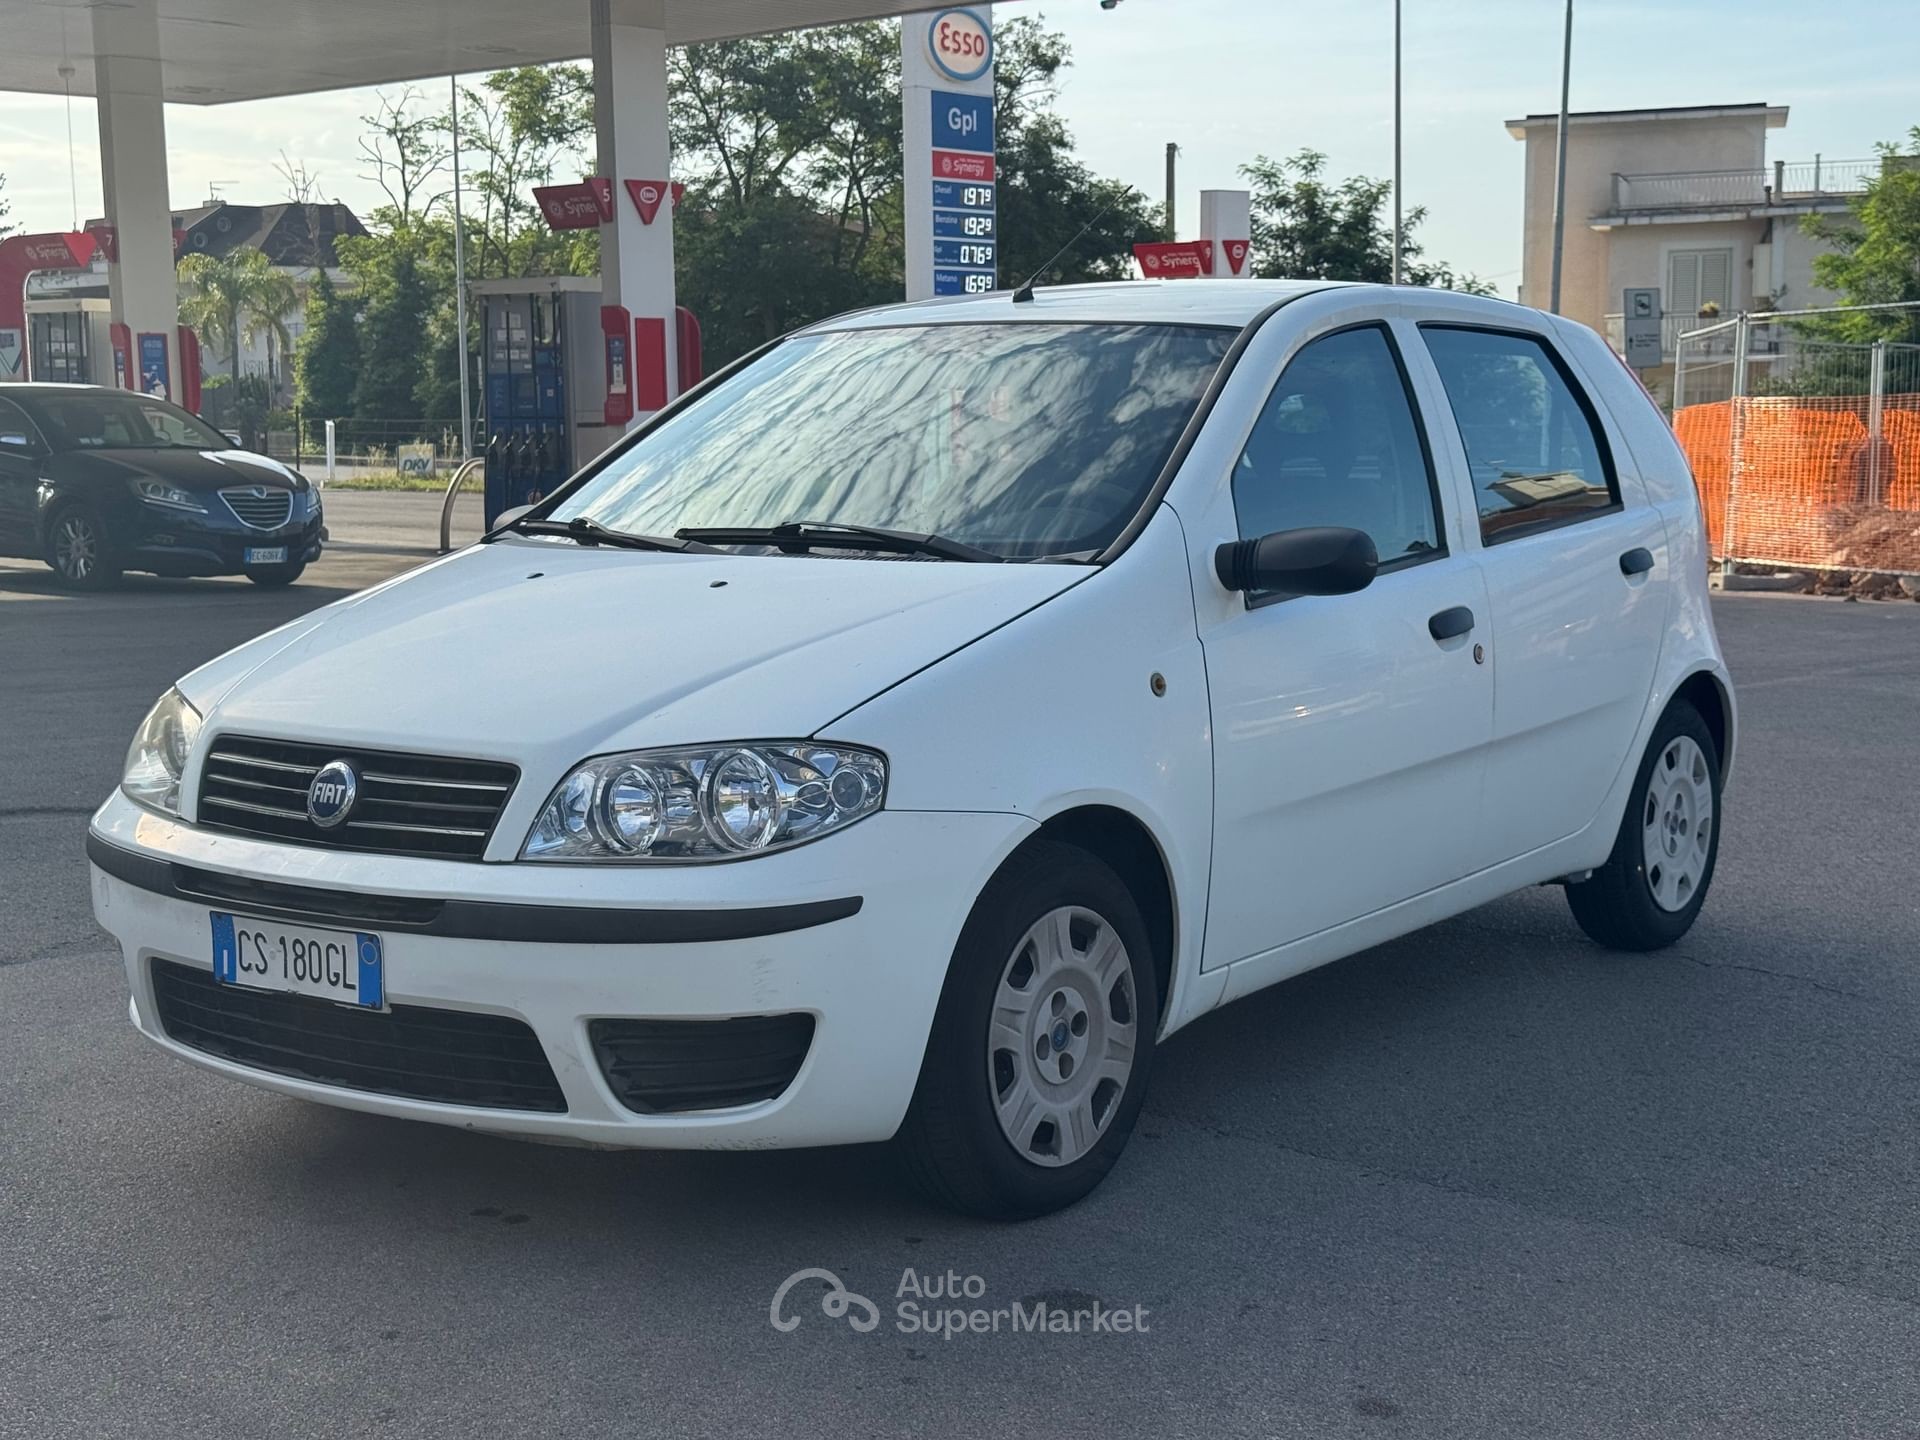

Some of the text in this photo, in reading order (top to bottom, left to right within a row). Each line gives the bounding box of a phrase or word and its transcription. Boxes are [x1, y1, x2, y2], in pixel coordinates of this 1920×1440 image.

[948, 107, 977, 137] Gpl
[953, 160, 985, 177] Synergy
[602, 188, 610, 202] 5
[934, 184, 952, 194] Diesel
[935, 214, 958, 224] Benzina
[105, 233, 113, 247] 7
[1160, 254, 1200, 269] Synerg
[936, 273, 958, 282] Metano
[403, 458, 430, 472] DKV
[312, 782, 346, 805] FIAT
[238, 930, 268, 975] CS
[279, 935, 357, 991] 180GL
